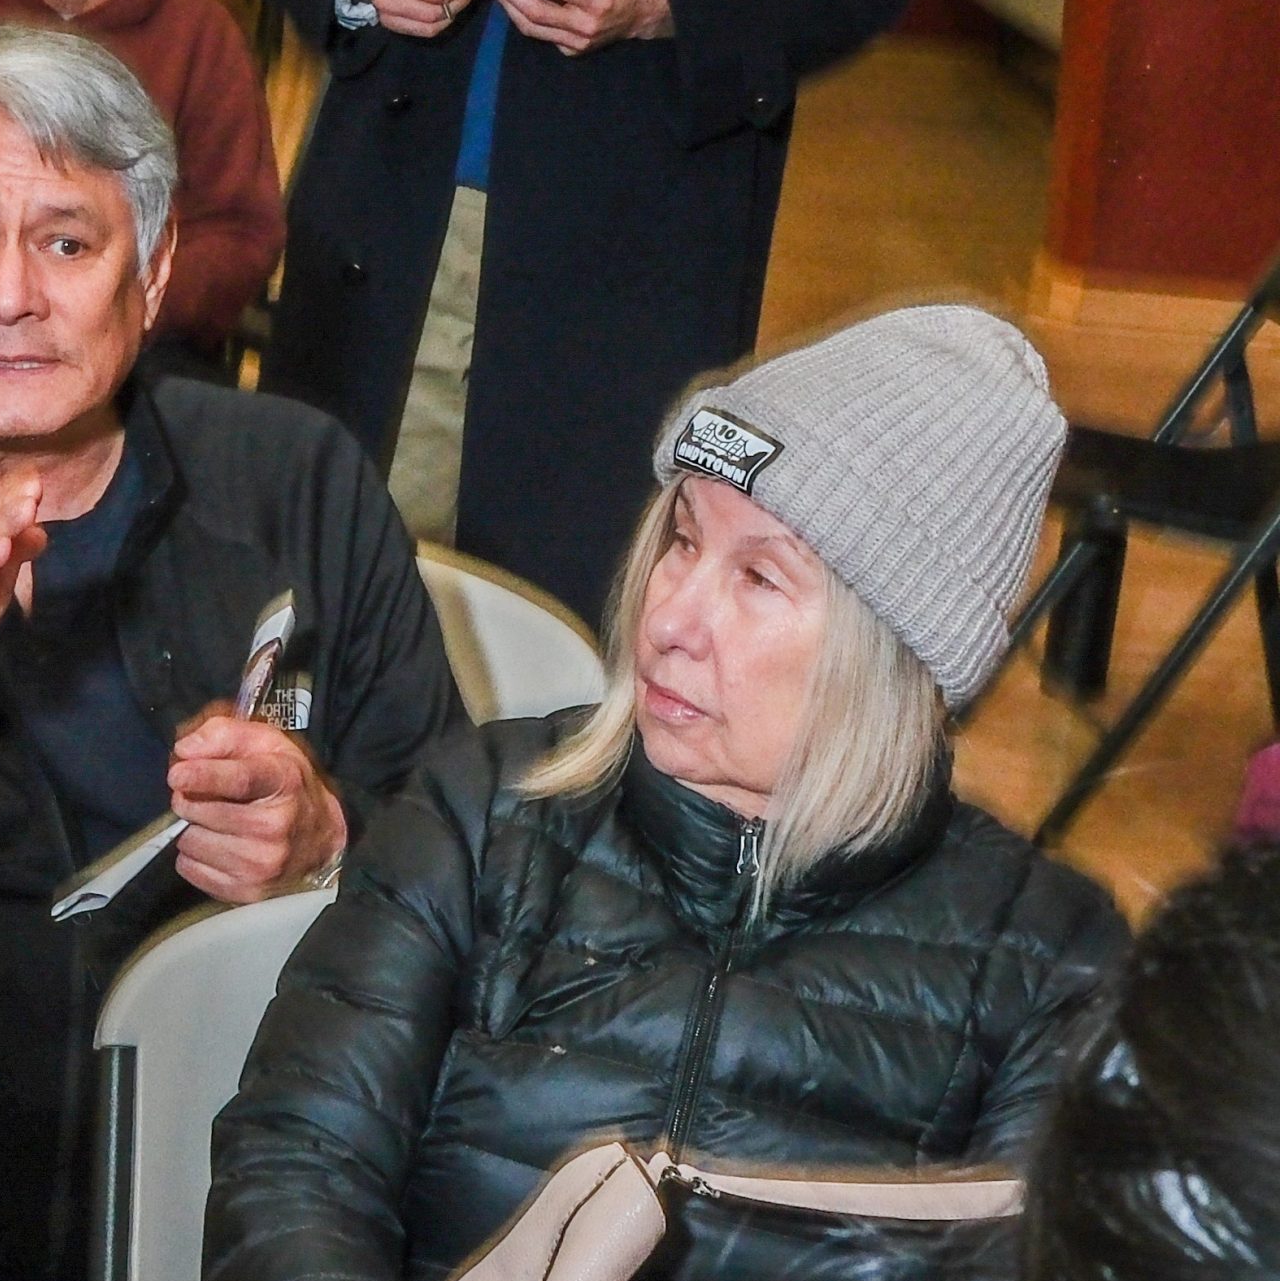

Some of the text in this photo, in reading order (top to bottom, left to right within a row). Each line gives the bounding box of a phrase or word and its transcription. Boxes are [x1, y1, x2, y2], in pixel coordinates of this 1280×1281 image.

[718, 424, 737, 440] 10
[678, 442, 747, 484] ANDYTOWN
[274, 688, 295, 703] THE
